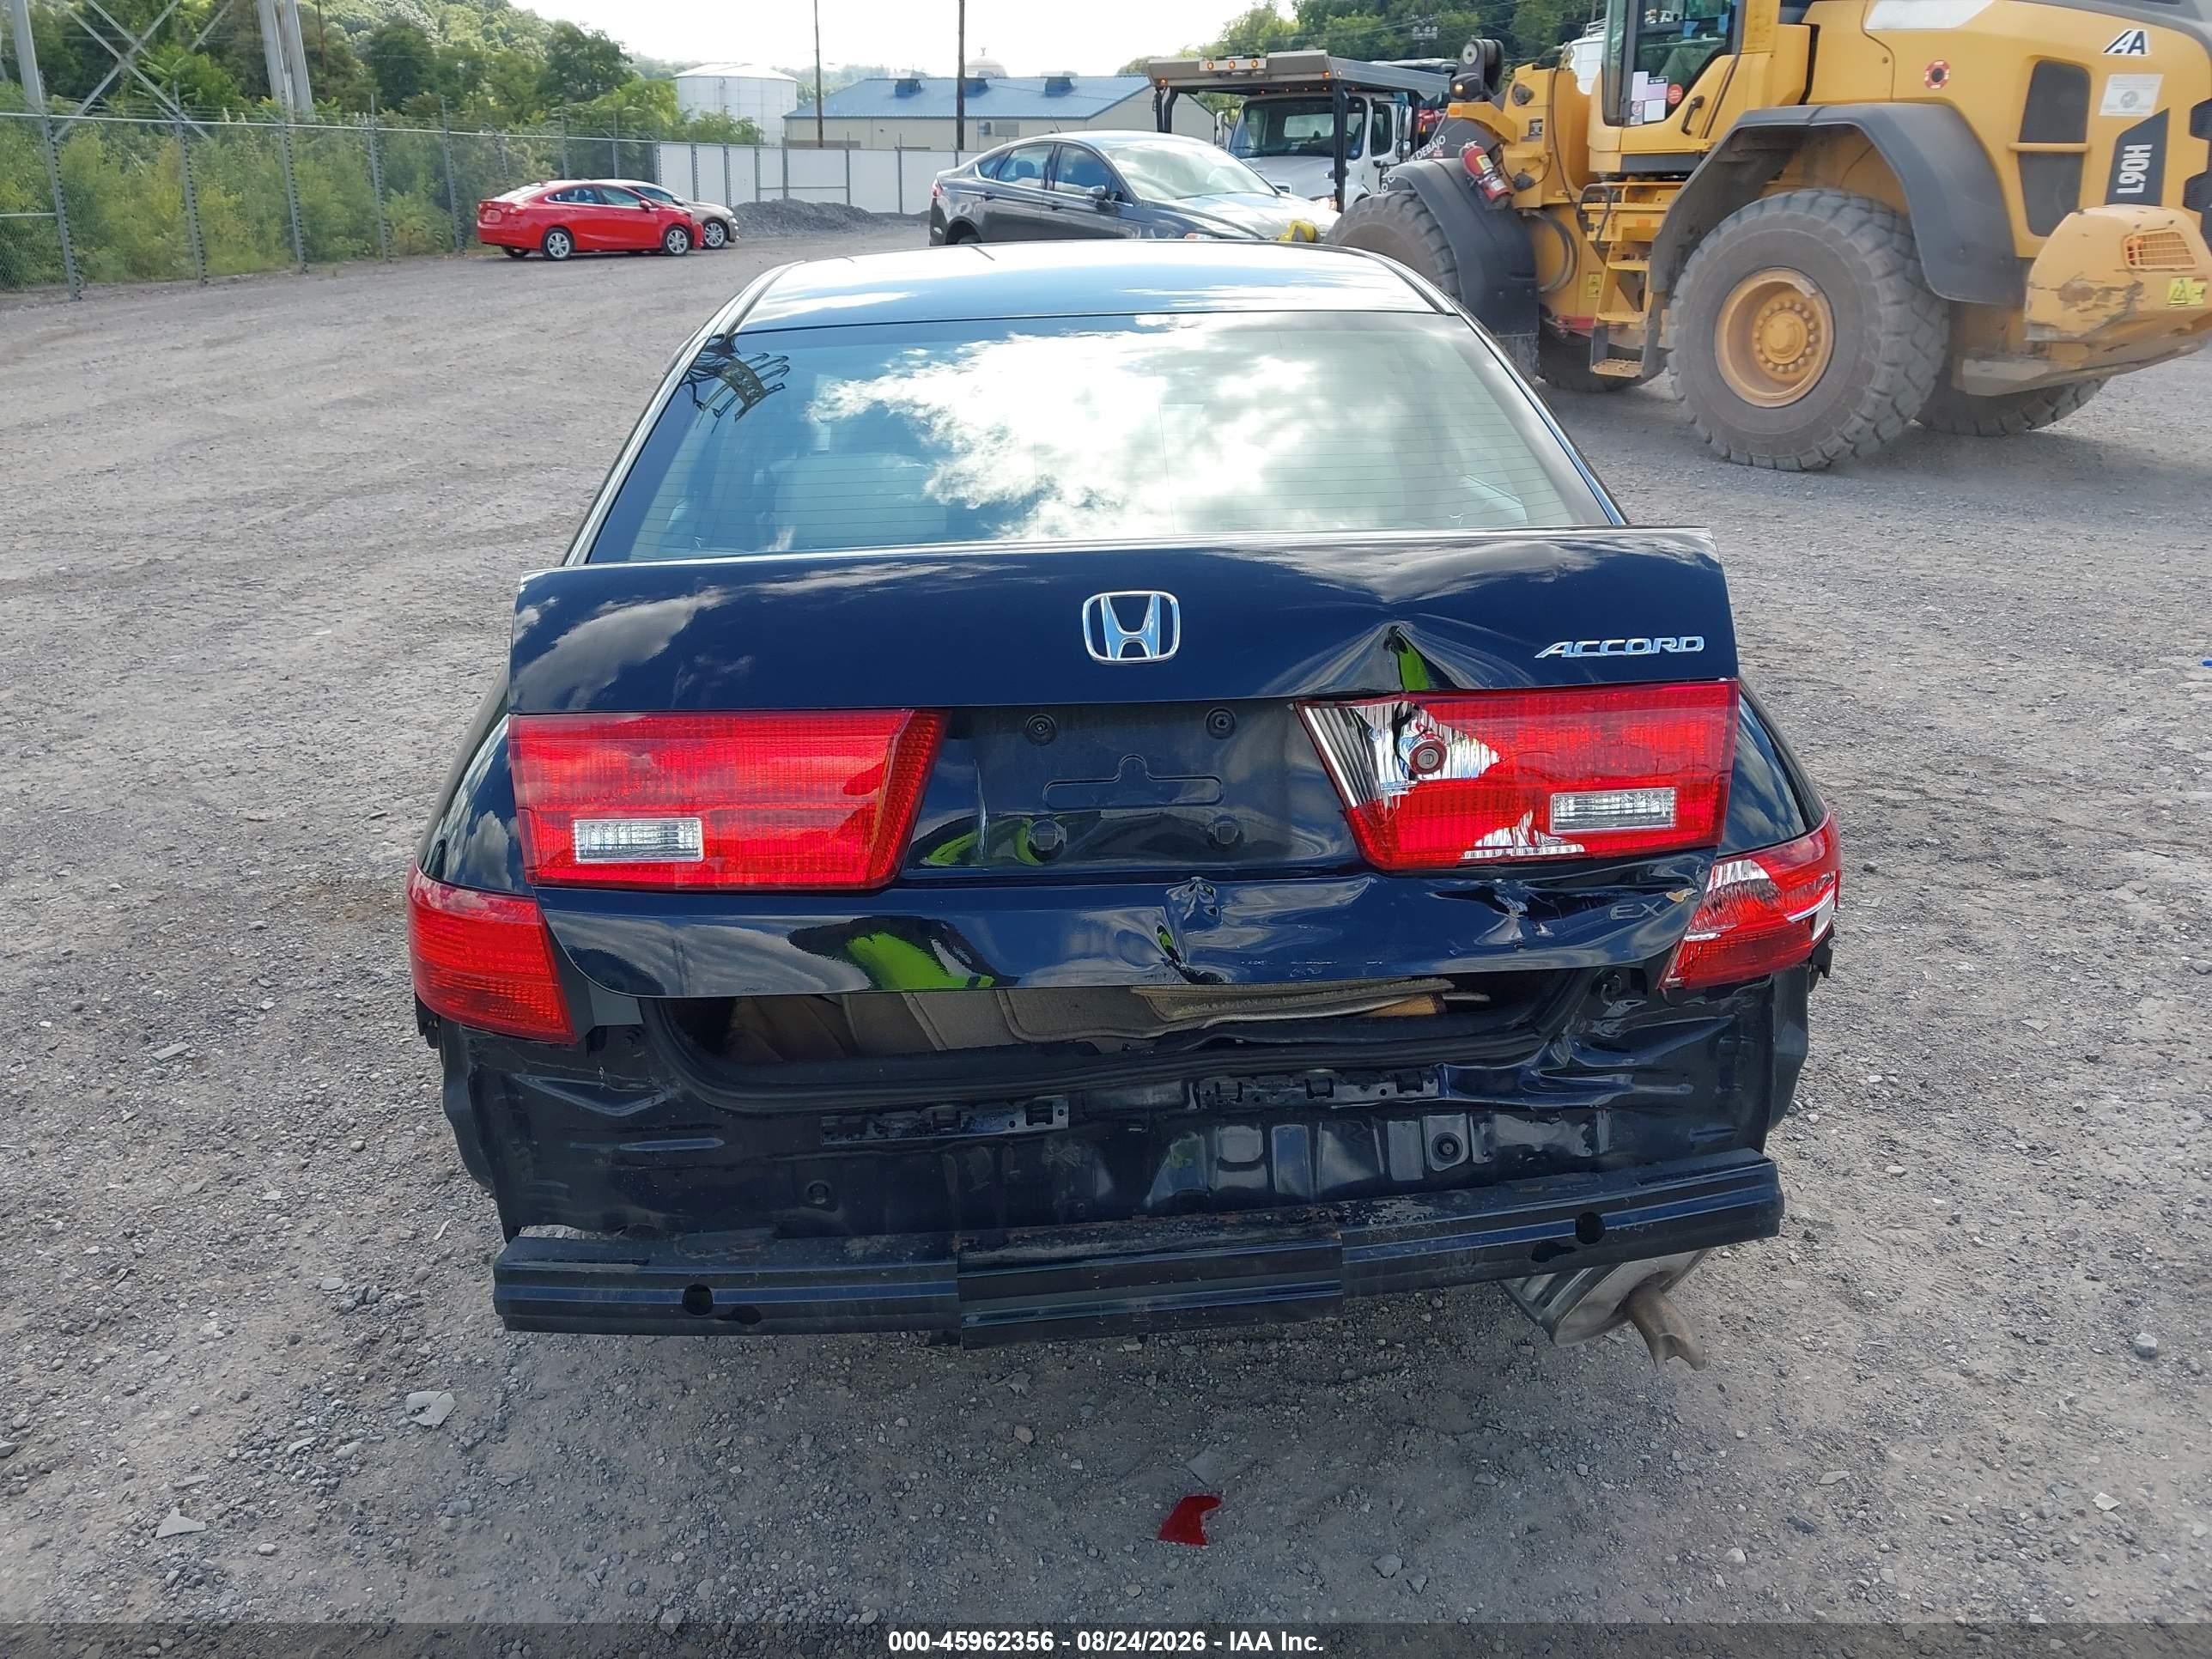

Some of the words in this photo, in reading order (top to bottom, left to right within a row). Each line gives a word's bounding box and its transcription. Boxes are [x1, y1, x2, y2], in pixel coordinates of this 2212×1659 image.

[1416, 135, 1446, 160] DEBAJO
[2116, 143, 2153, 194] L90H
[1534, 635, 1705, 658] ACCORD
[1610, 901, 1661, 920] EX
